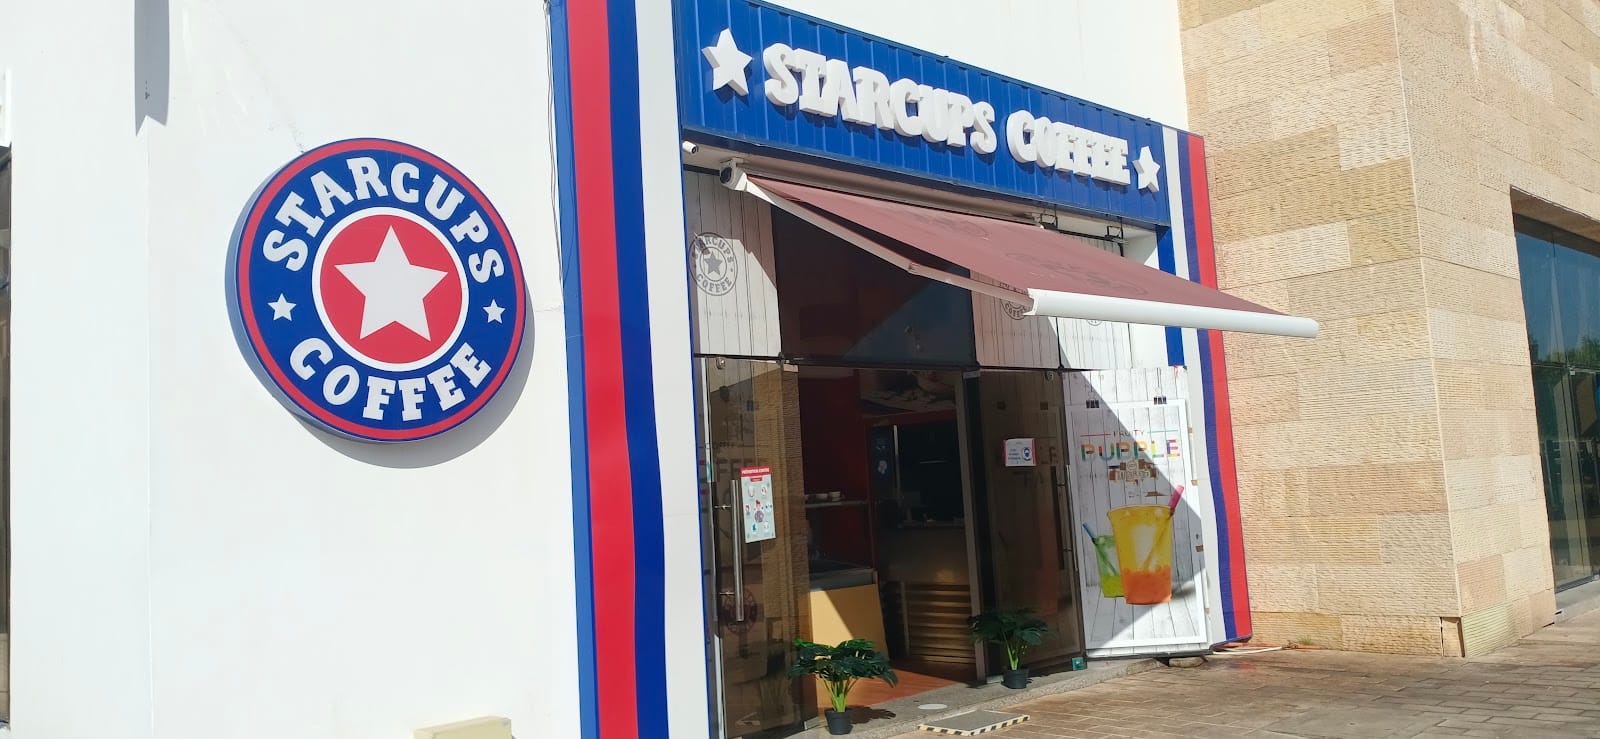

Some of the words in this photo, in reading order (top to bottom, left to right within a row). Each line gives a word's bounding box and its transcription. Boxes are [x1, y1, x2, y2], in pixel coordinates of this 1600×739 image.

[763, 43, 997, 155] STARCUPS
[1006, 109, 1131, 186] COFFEE
[262, 156, 505, 284] STARCUPS
[696, 272, 732, 293] COFFEE
[289, 337, 492, 422] COFFEE
[1080, 438, 1181, 462] PUPPLE
